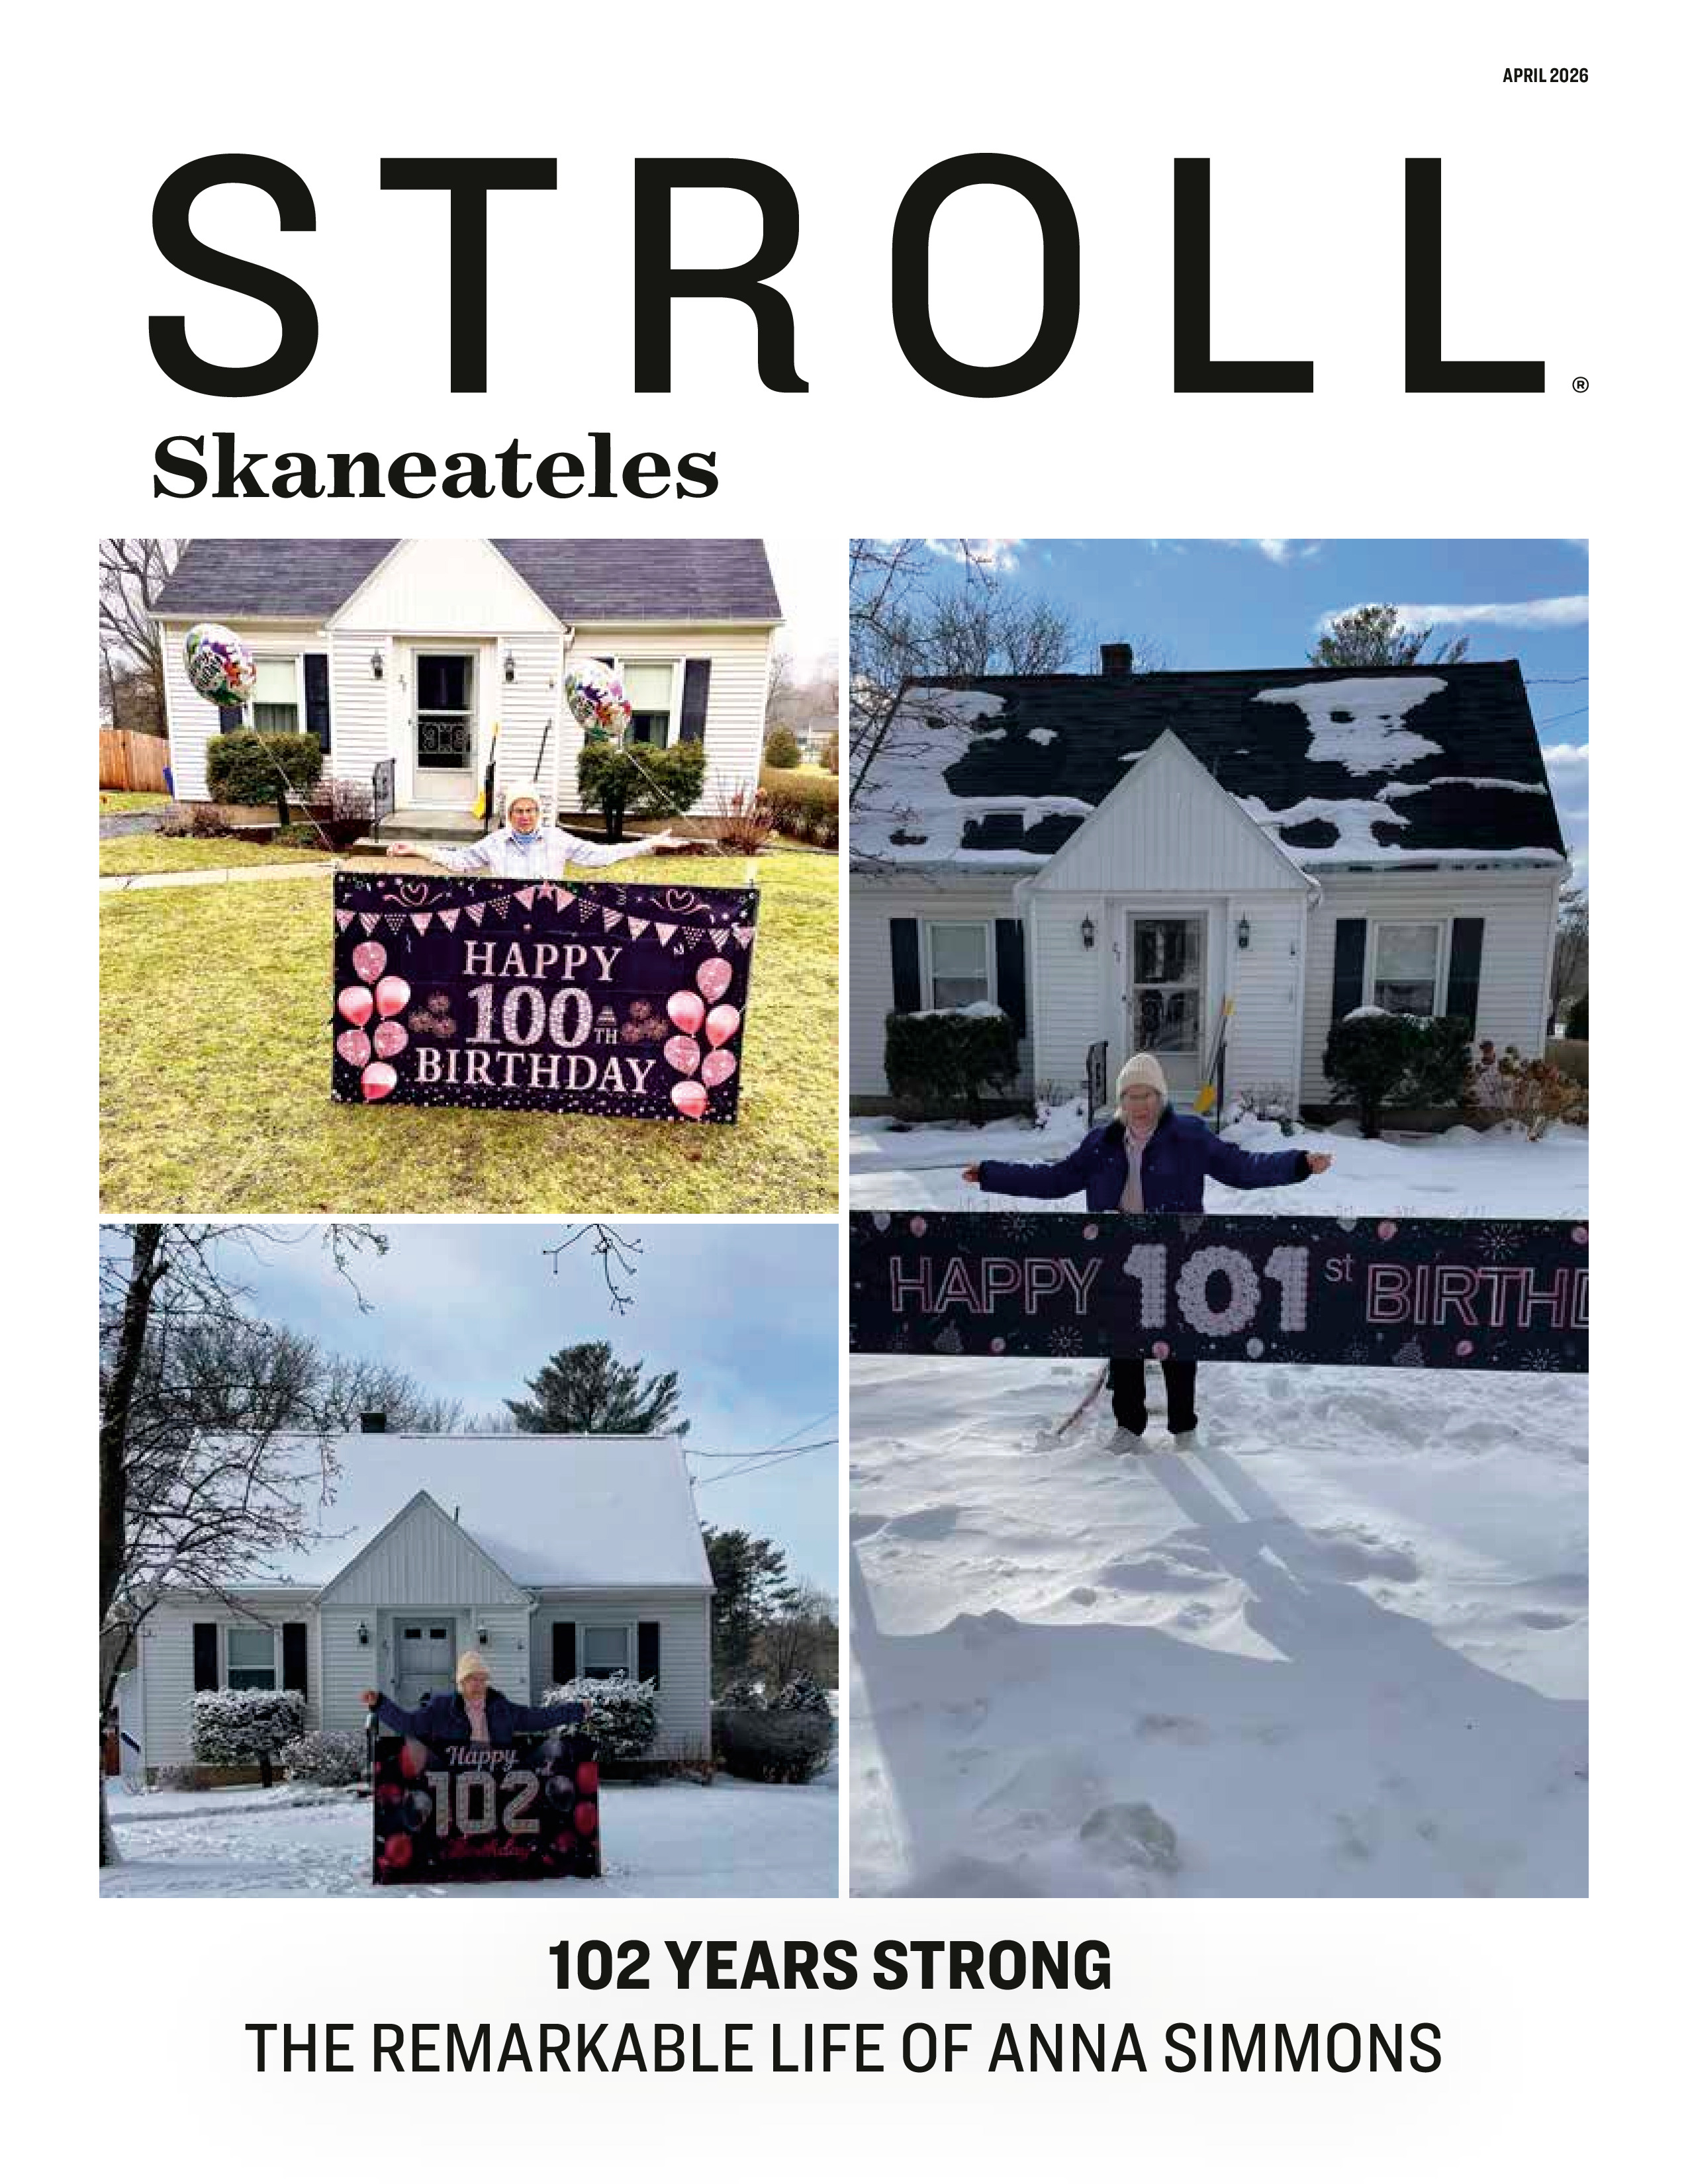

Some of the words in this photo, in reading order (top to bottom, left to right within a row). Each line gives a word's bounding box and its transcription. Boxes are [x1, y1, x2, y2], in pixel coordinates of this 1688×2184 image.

[463, 939, 623, 982] HAPPY
[466, 983, 594, 1048] 100
[594, 1026, 619, 1045] TH
[414, 1047, 657, 1095] BIRTHDAY
[890, 1256, 1103, 1316] HAPPY
[1123, 1242, 1310, 1338] 101
[1325, 1252, 1354, 1283] st
[445, 1745, 520, 1772] Happy
[424, 1770, 540, 1838] 102
